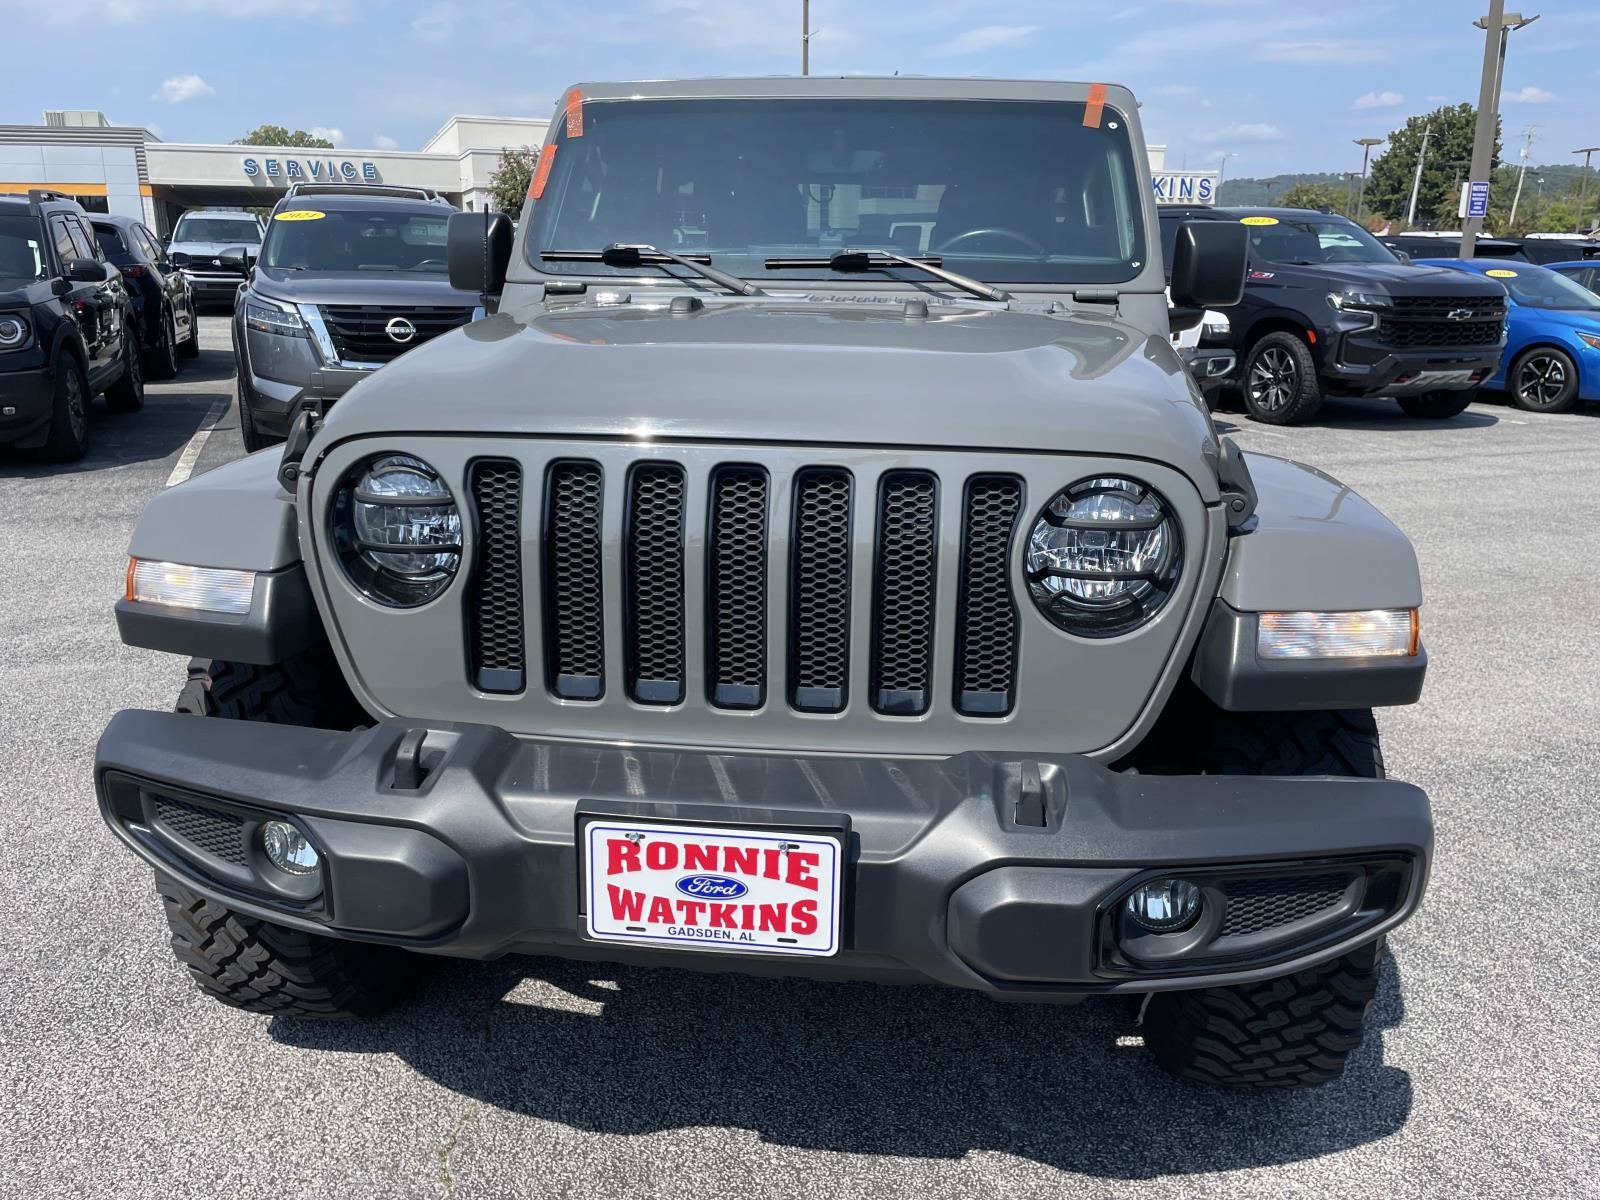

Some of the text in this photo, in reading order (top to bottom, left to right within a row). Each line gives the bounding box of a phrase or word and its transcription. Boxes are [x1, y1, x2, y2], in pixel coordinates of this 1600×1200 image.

[243, 158, 377, 180] SERVICE
[1152, 176, 1212, 199] KINS
[385, 326, 416, 334] NISSAN
[606, 838, 819, 892] RONNIE
[687, 876, 738, 896] Ford
[606, 883, 818, 936] WATKINS
[667, 926, 756, 942] GADSDEN, AL
